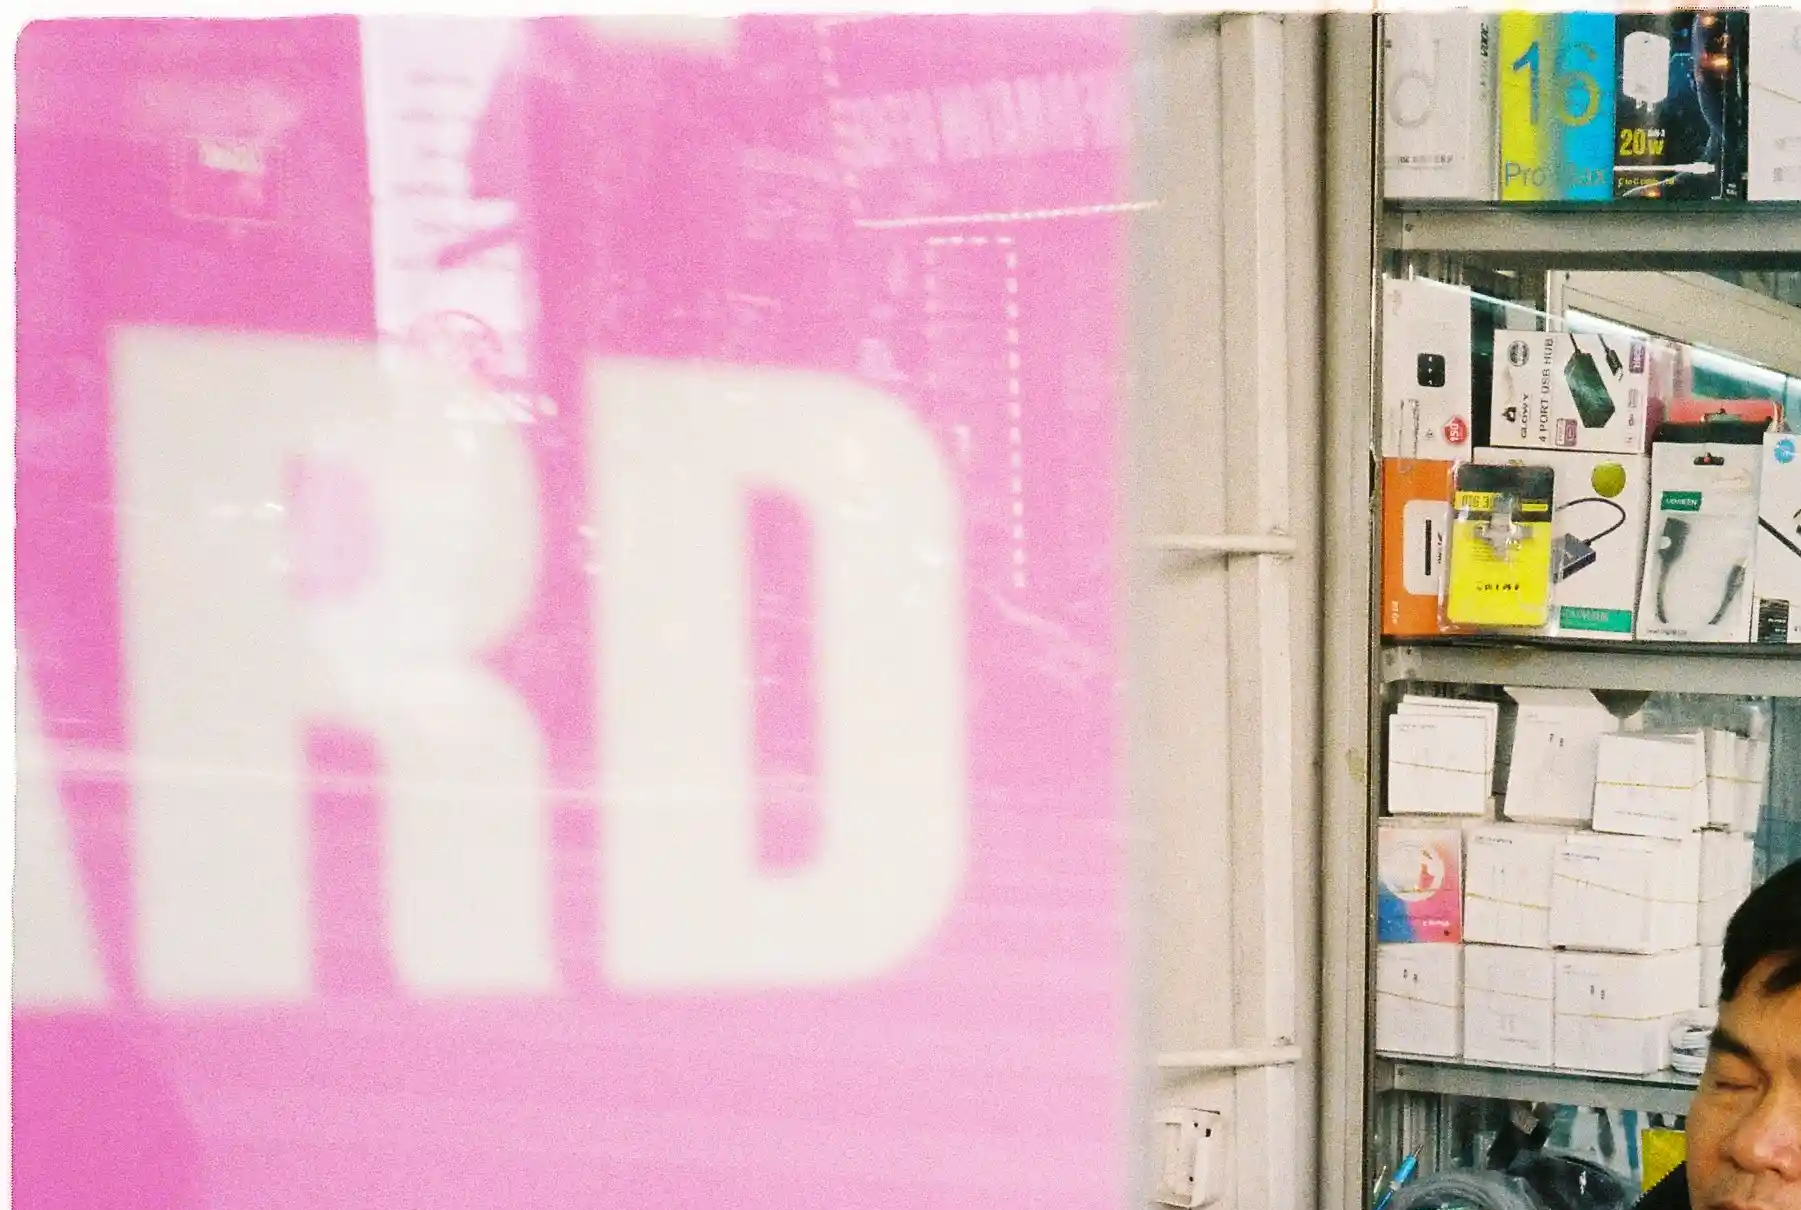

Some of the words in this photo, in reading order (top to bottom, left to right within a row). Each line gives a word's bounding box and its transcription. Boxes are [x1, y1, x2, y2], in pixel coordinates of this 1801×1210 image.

[1512, 39, 1600, 126] 16
[1505, 162, 1546, 187] Pro
[1541, 367, 1551, 395] USB
[1539, 399, 1549, 432] PORT
[14, 323, 967, 1008] RD
